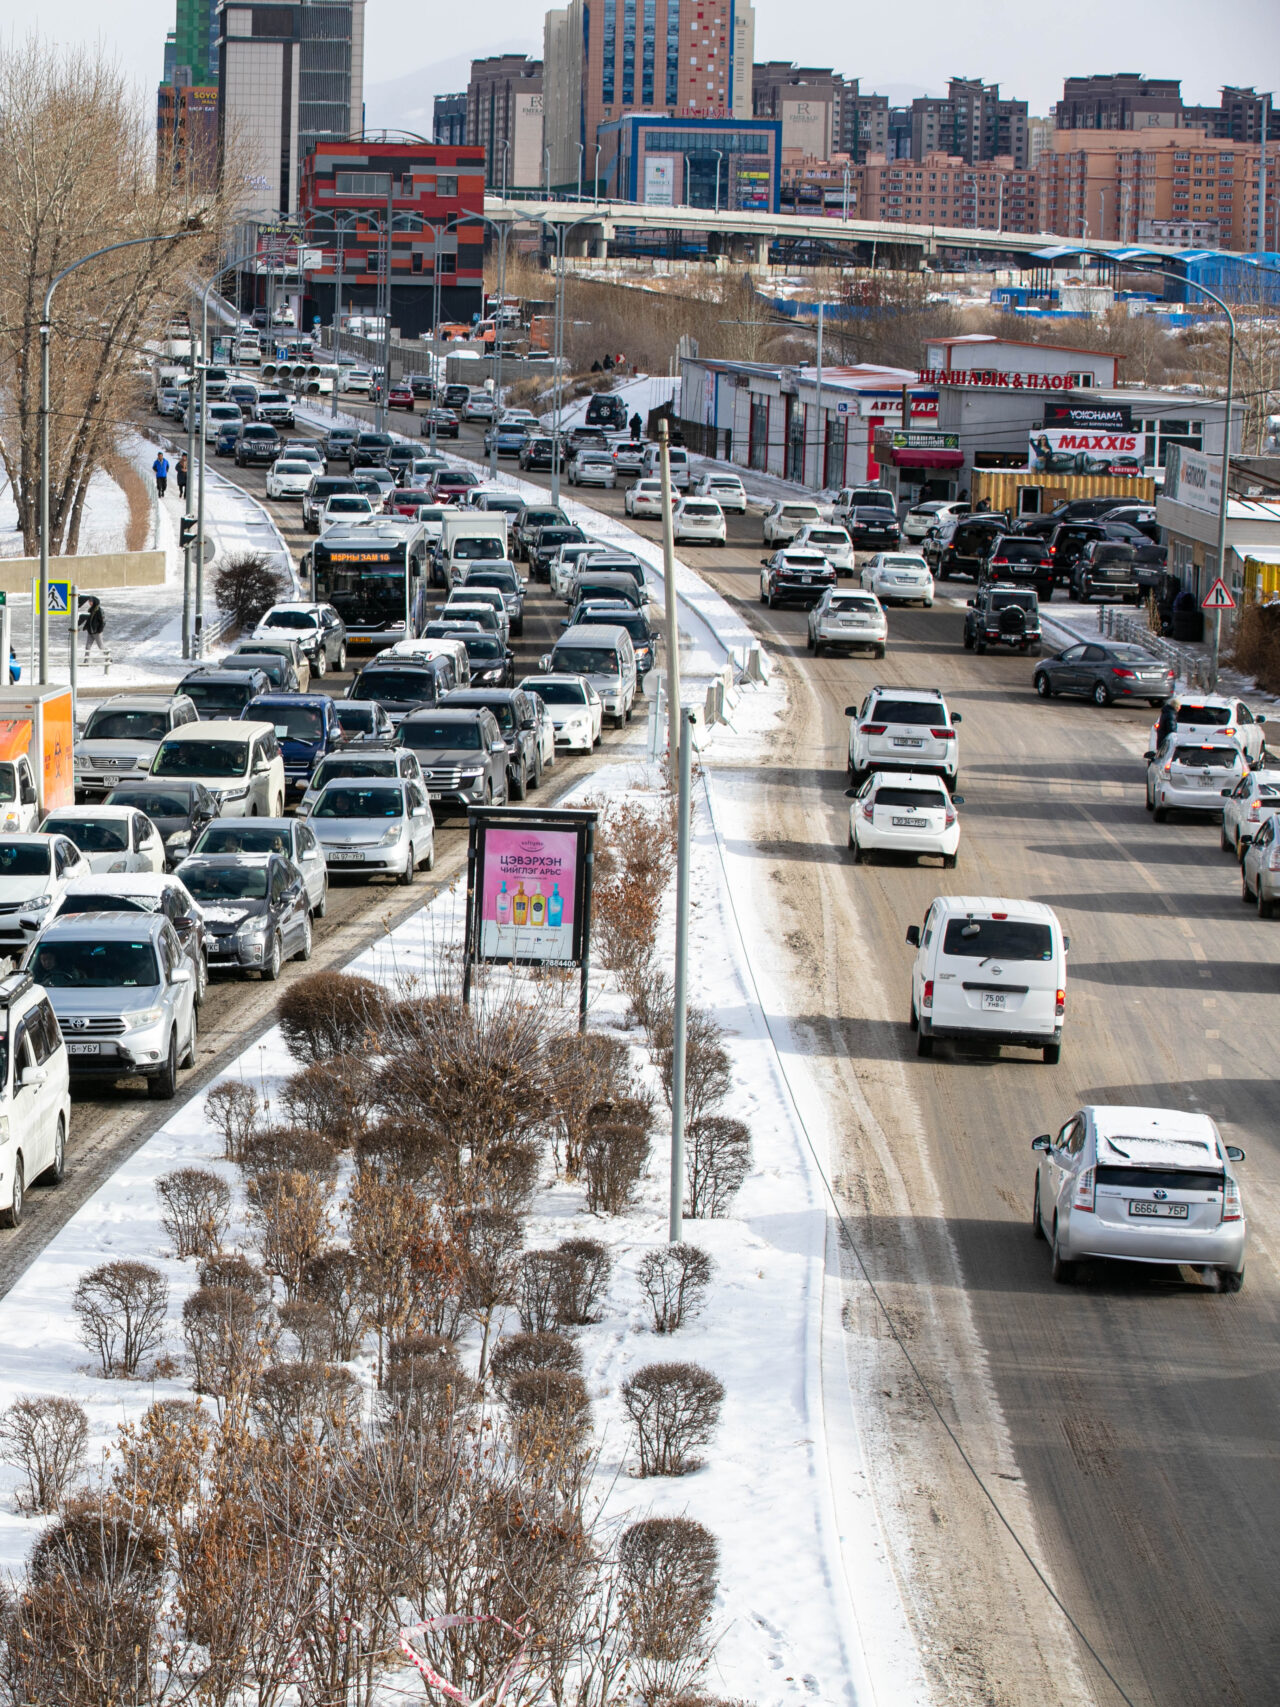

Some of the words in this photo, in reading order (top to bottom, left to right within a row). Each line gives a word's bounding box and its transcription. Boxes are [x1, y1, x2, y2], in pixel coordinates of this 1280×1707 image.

[920, 370, 1008, 387] ШАШЛЫК
[1012, 373, 1023, 388] &
[1027, 374, 1074, 390] ПЛОВ
[1070, 410, 1123, 420] YOKOHAMA
[1058, 435, 1136, 451] MAXXIS
[500, 856, 562, 867] ЦЭВЭРХЭН
[500, 866, 538, 875] ЧИЙГЛЭГ
[540, 868, 562, 876] АРЬС
[82, 1045, 98, 1053] УБУ
[1134, 1204, 1158, 1213] 6664
[1168, 1205, 1186, 1215] УБР
